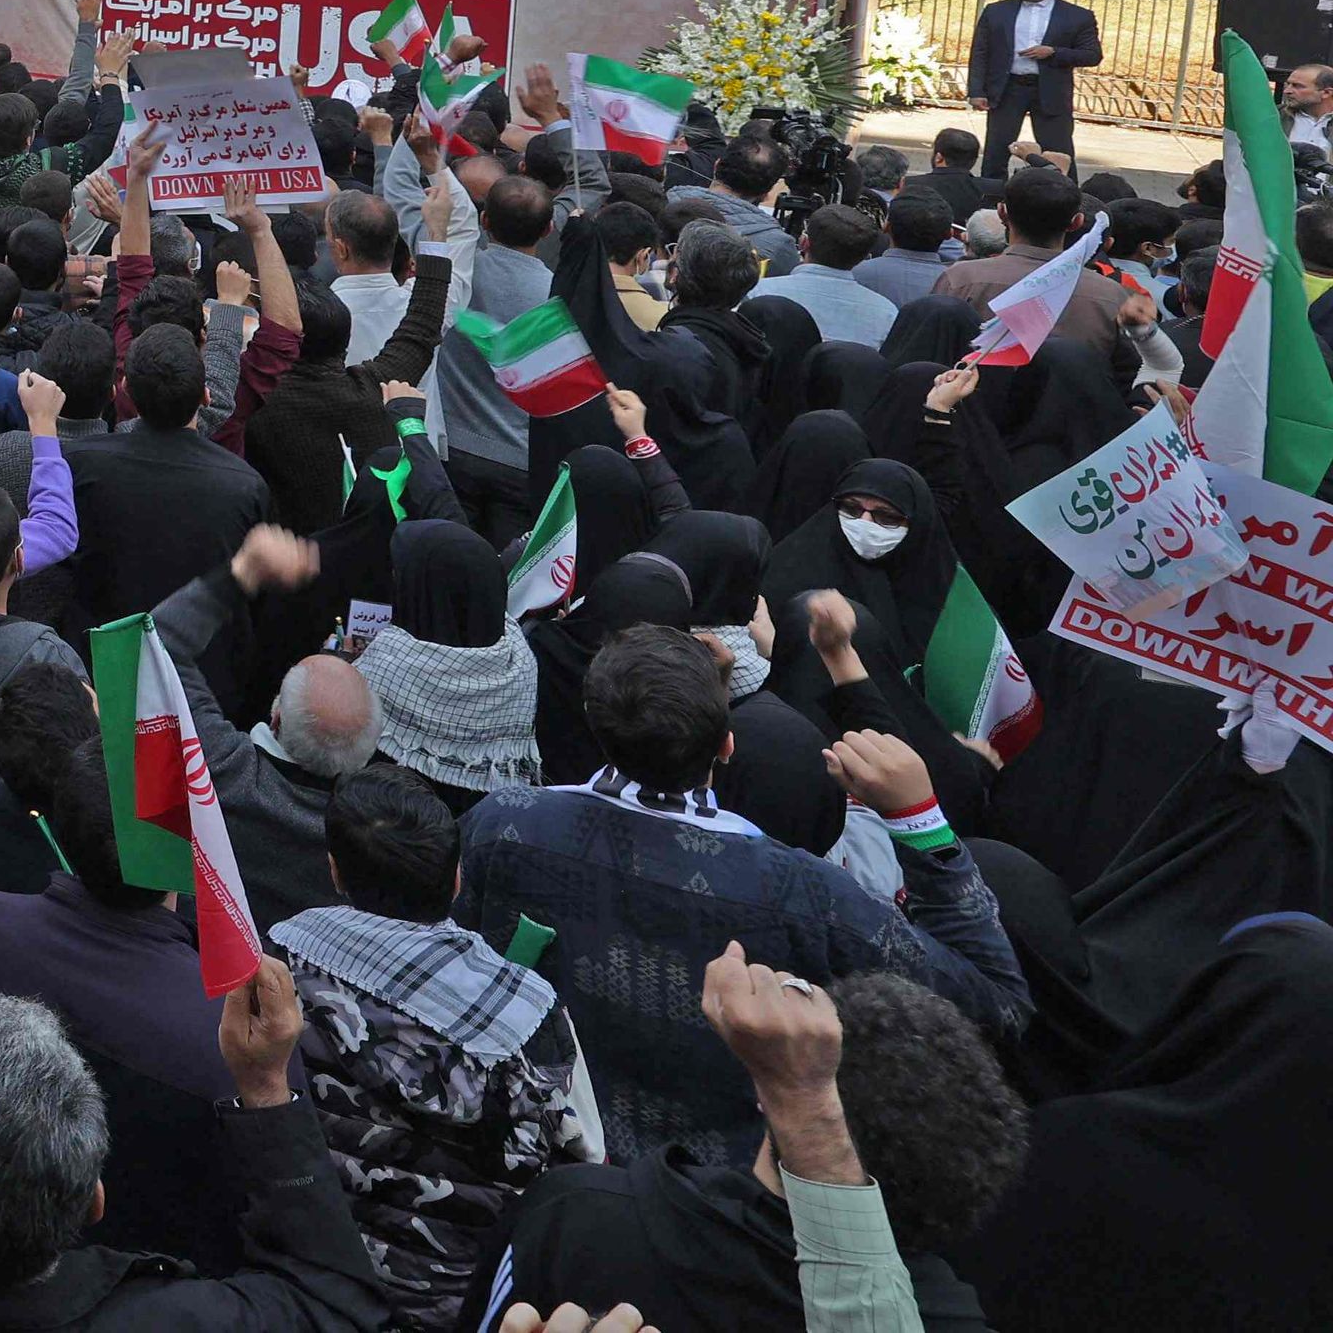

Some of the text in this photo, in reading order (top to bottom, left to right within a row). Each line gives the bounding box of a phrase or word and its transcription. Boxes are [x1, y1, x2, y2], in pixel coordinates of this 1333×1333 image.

[193, 4, 214, 26] بر
[190, 29, 214, 52] بر
[214, 27, 277, 53] مرگ
[144, 104, 183, 123] آمریکا
[200, 104, 228, 120] مرگ
[231, 99, 256, 118] شعار
[259, 100, 291, 114] همین
[177, 125, 219, 143] اسرائیل
[235, 123, 265, 139] مرگ
[269, 125, 276, 138] و
[162, 141, 307, 168] برای آنها مرگ می آورد
[159, 176, 216, 197] DOWN
[281, 168, 318, 189] USA
[1059, 431, 1189, 534] #ایران_قوی
[353, 611, 376, 622] فروش
[1069, 605, 1211, 672] DOWN
